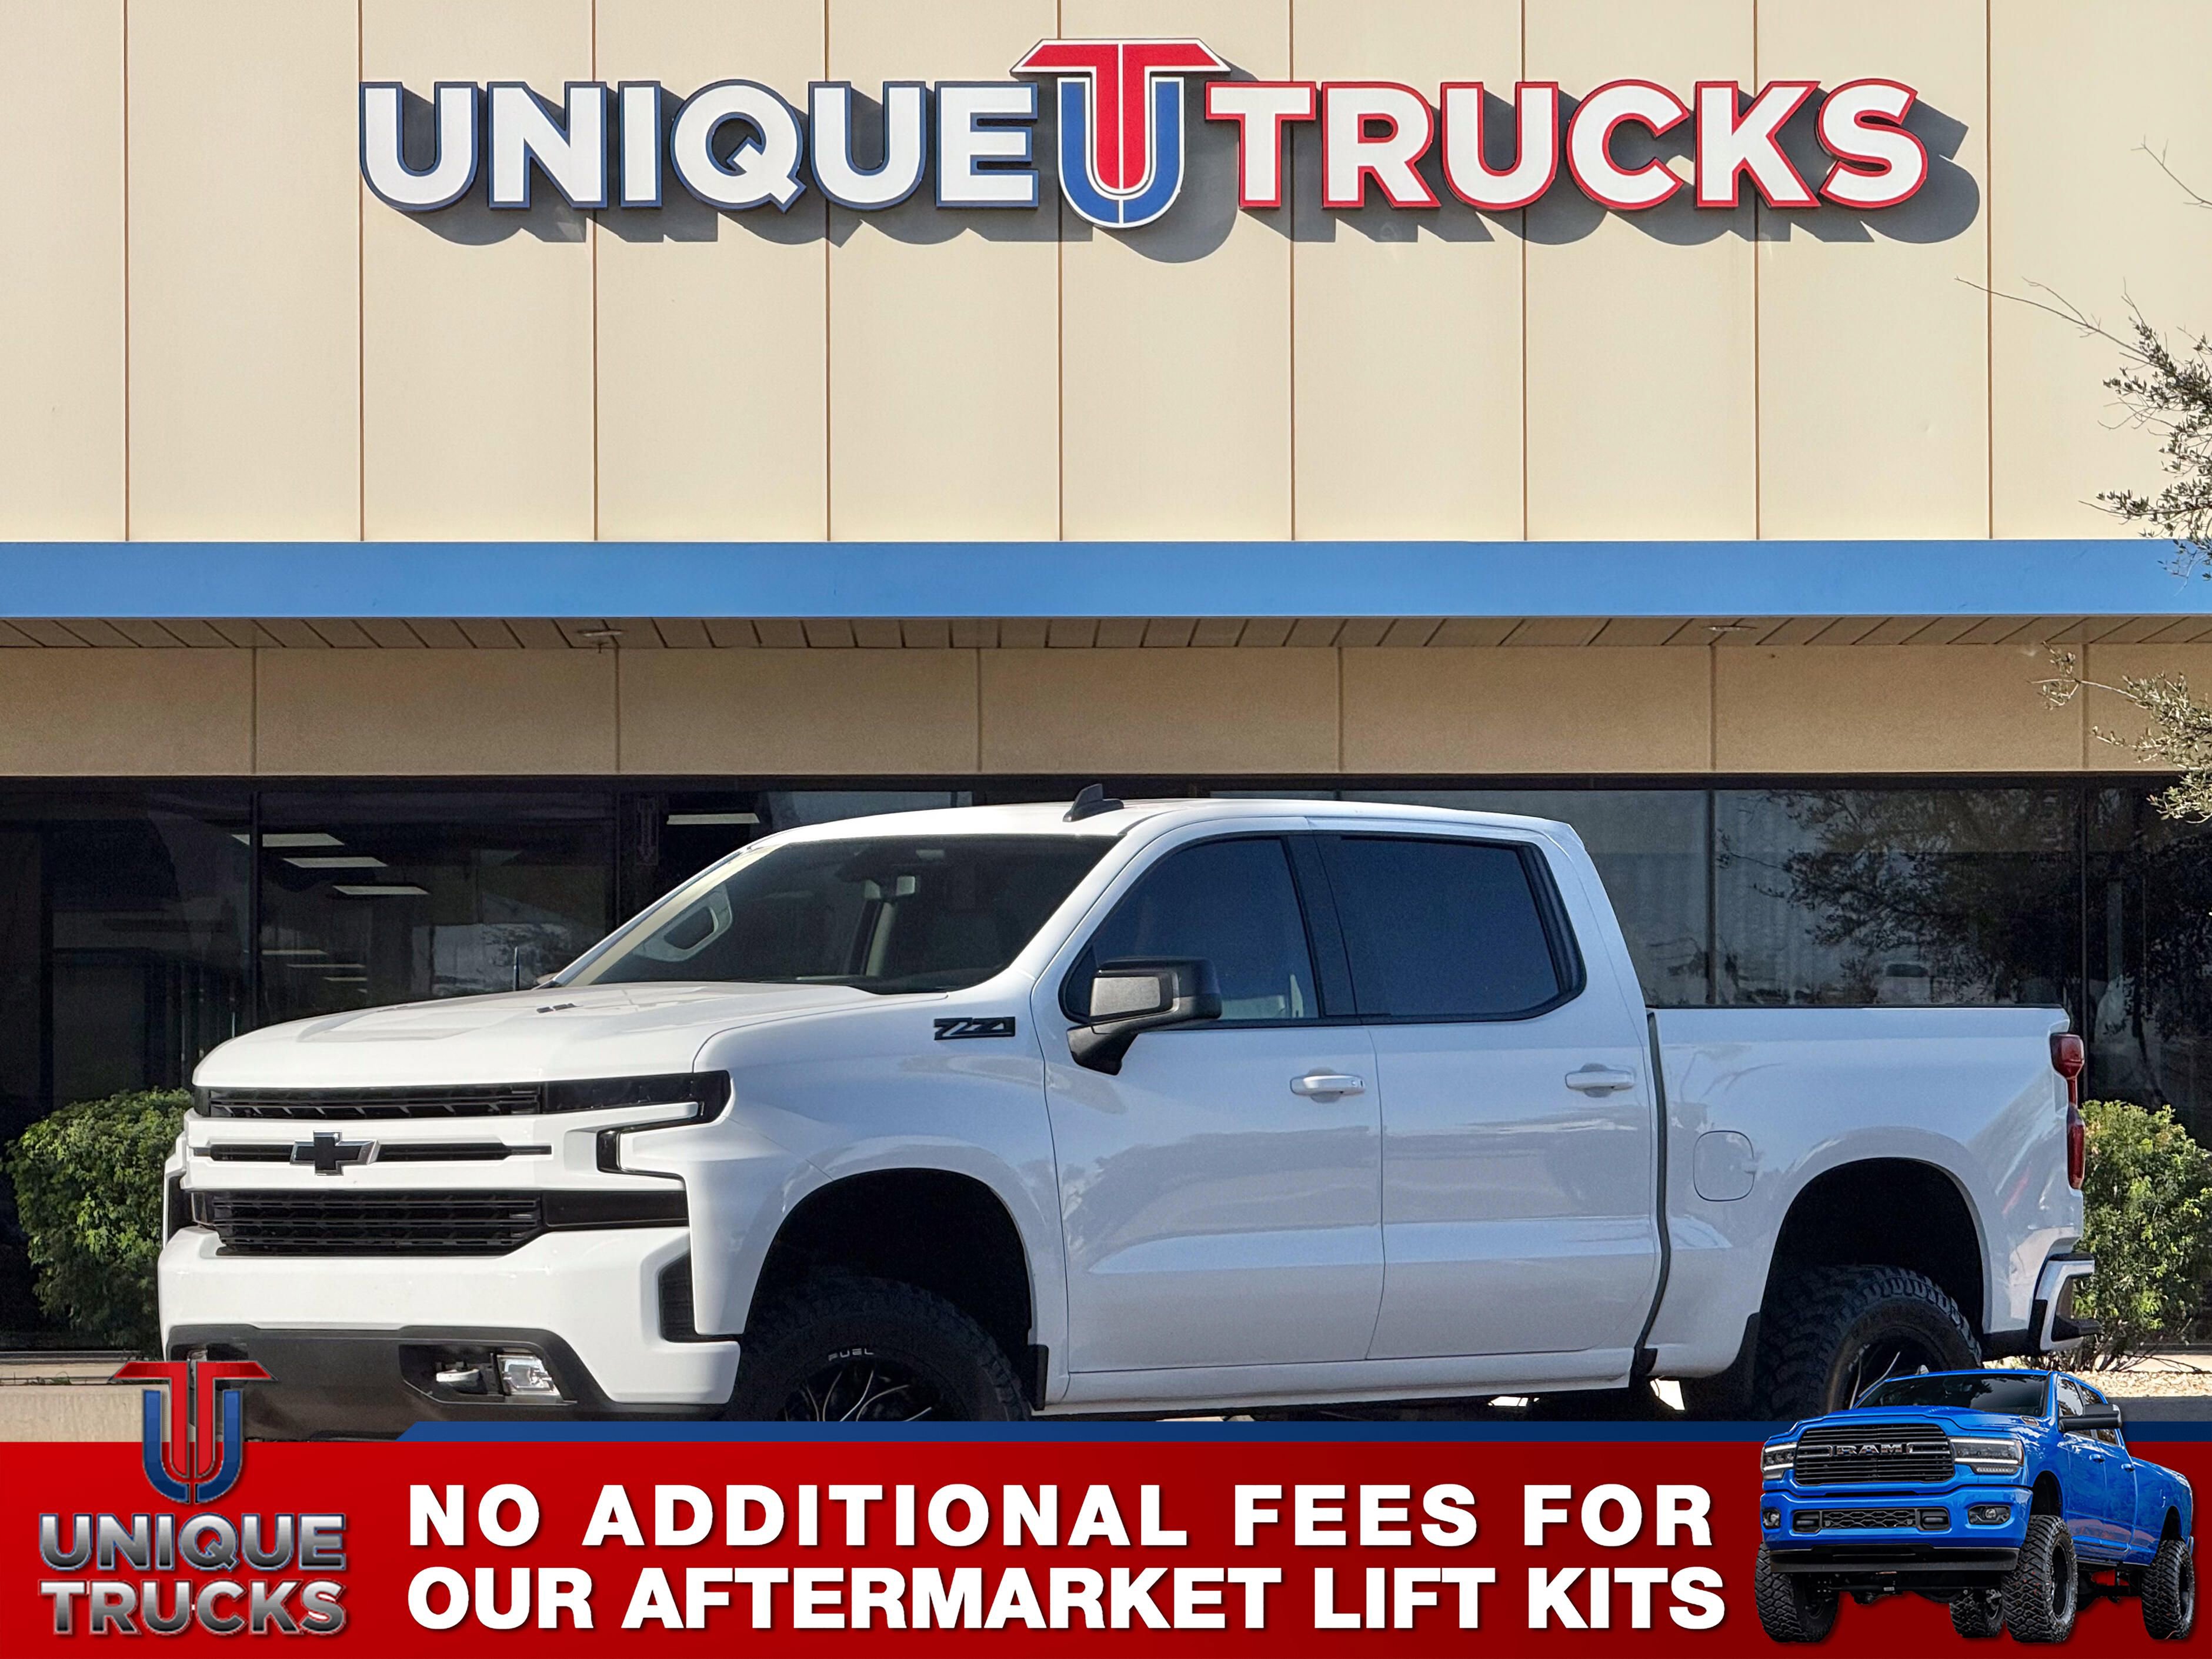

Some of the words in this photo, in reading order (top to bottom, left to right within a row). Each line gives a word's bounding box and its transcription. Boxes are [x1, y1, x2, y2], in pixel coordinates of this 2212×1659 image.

[360, 79, 1039, 214] UNIQUE
[1205, 79, 1927, 211] TRUCKS
[828, 1348, 874, 1361] FUEL
